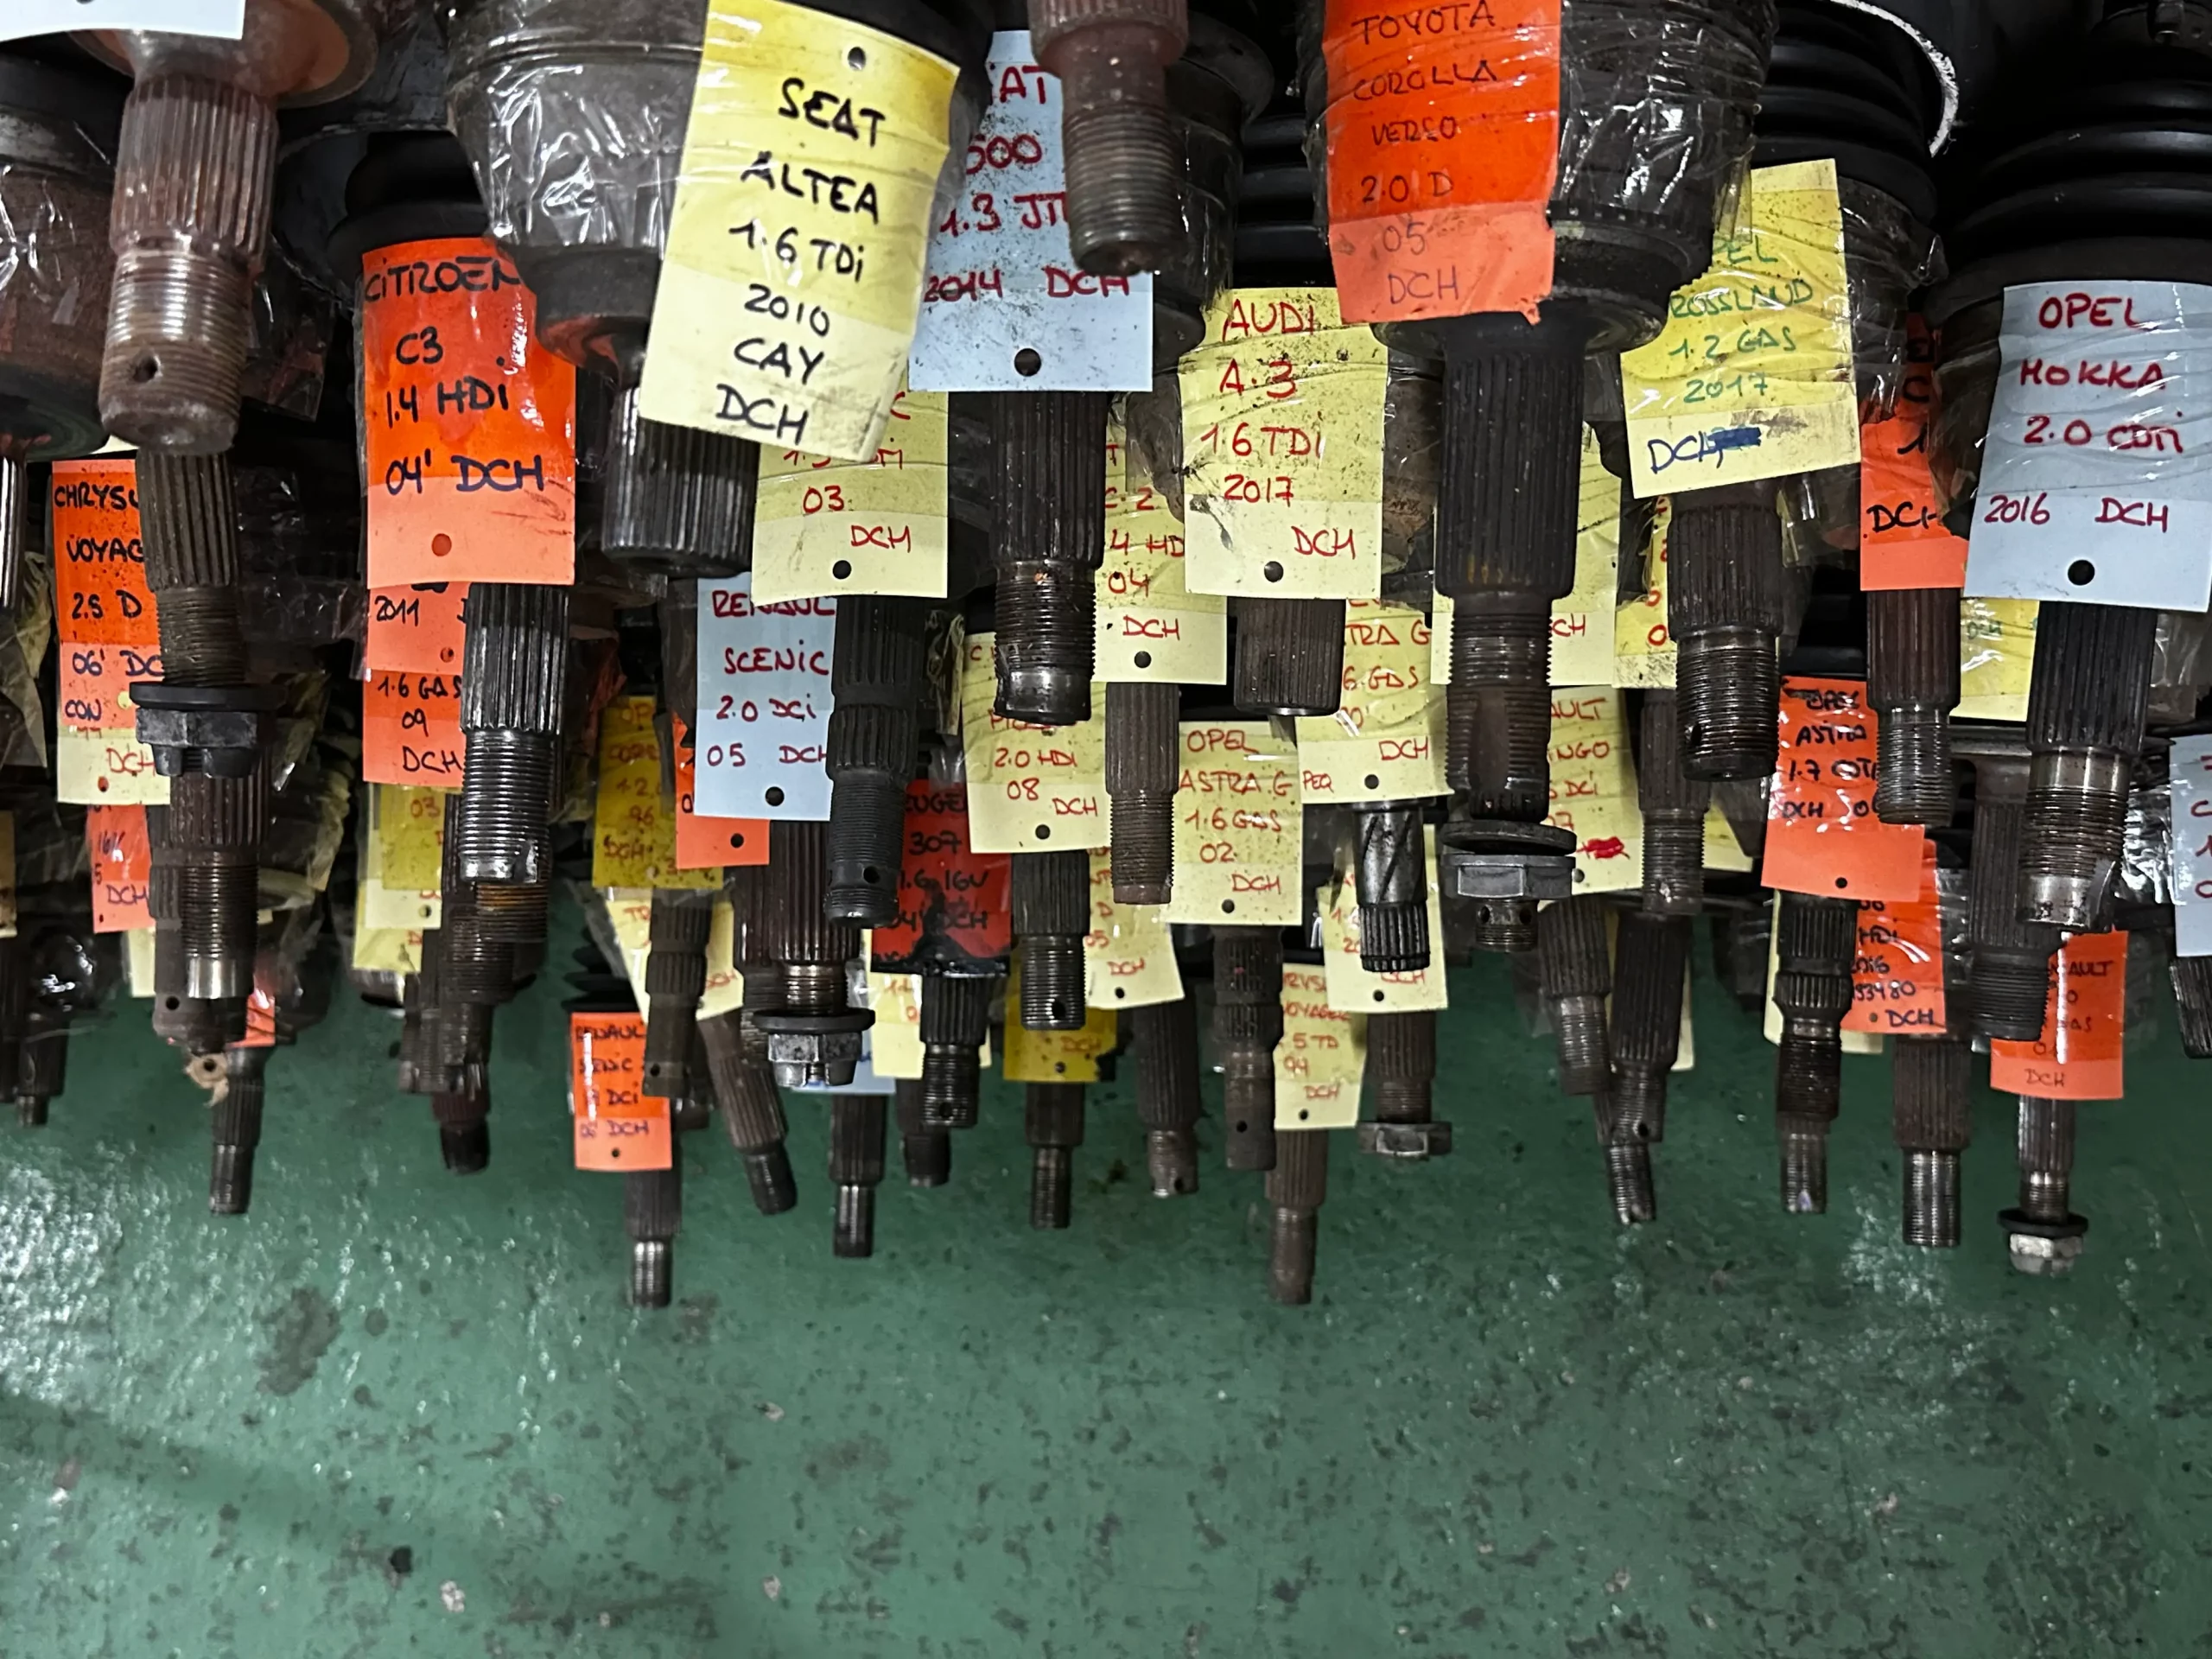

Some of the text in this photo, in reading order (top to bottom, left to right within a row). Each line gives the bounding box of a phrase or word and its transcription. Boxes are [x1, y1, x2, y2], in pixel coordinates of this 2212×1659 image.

[1351, 0, 1496, 44] TOYOTA
[1353, 60, 1497, 101] COROLLA
[778, 78, 885, 147] SEAT
[741, 151, 880, 224] ALTEA
[728, 218, 798, 264] 1.6
[1383, 222, 1426, 256] 05
[924, 265, 1130, 303] 2014 DCH
[1388, 265, 1459, 303] DCH
[744, 283, 830, 337] 2010
[1223, 299, 1314, 342] AUDI
[2039, 293, 2158, 330] OPEL
[396, 326, 444, 365] C3
[734, 337, 823, 385] CAY
[1682, 372, 1768, 404] 2017
[385, 385, 419, 429] 1.4
[715, 384, 809, 445] DCH
[2024, 416, 2092, 446] 2.0
[450, 454, 544, 493] DCH
[803, 485, 844, 514] 03
[1224, 474, 1294, 507] 2017
[1984, 493, 2169, 533] 2016 DCH
[850, 524, 912, 554] DCH
[1291, 525, 1356, 560] DCH
[1108, 567, 1149, 598] 04
[115, 589, 143, 619] D
[374, 595, 419, 626] 2011
[1122, 614, 1181, 641] DCH
[65, 698, 102, 721] CON
[402, 708, 429, 738] 09
[716, 696, 758, 722] 2.0
[707, 743, 746, 767] 05
[1186, 728, 1260, 754] OPEL
[1378, 735, 1429, 761] DCH
[403, 746, 463, 774] DCH
[995, 747, 1031, 768] 2.0
[1007, 777, 1040, 801] 08
[1180, 769, 1262, 795] ASTRA
[1052, 797, 1098, 817] DCH
[1185, 807, 1228, 831] 1.6
[908, 830, 963, 856] 307
[1199, 842, 1235, 863] 02
[1231, 873, 1282, 895] DCH
[1885, 1007, 1935, 1028] DCH
